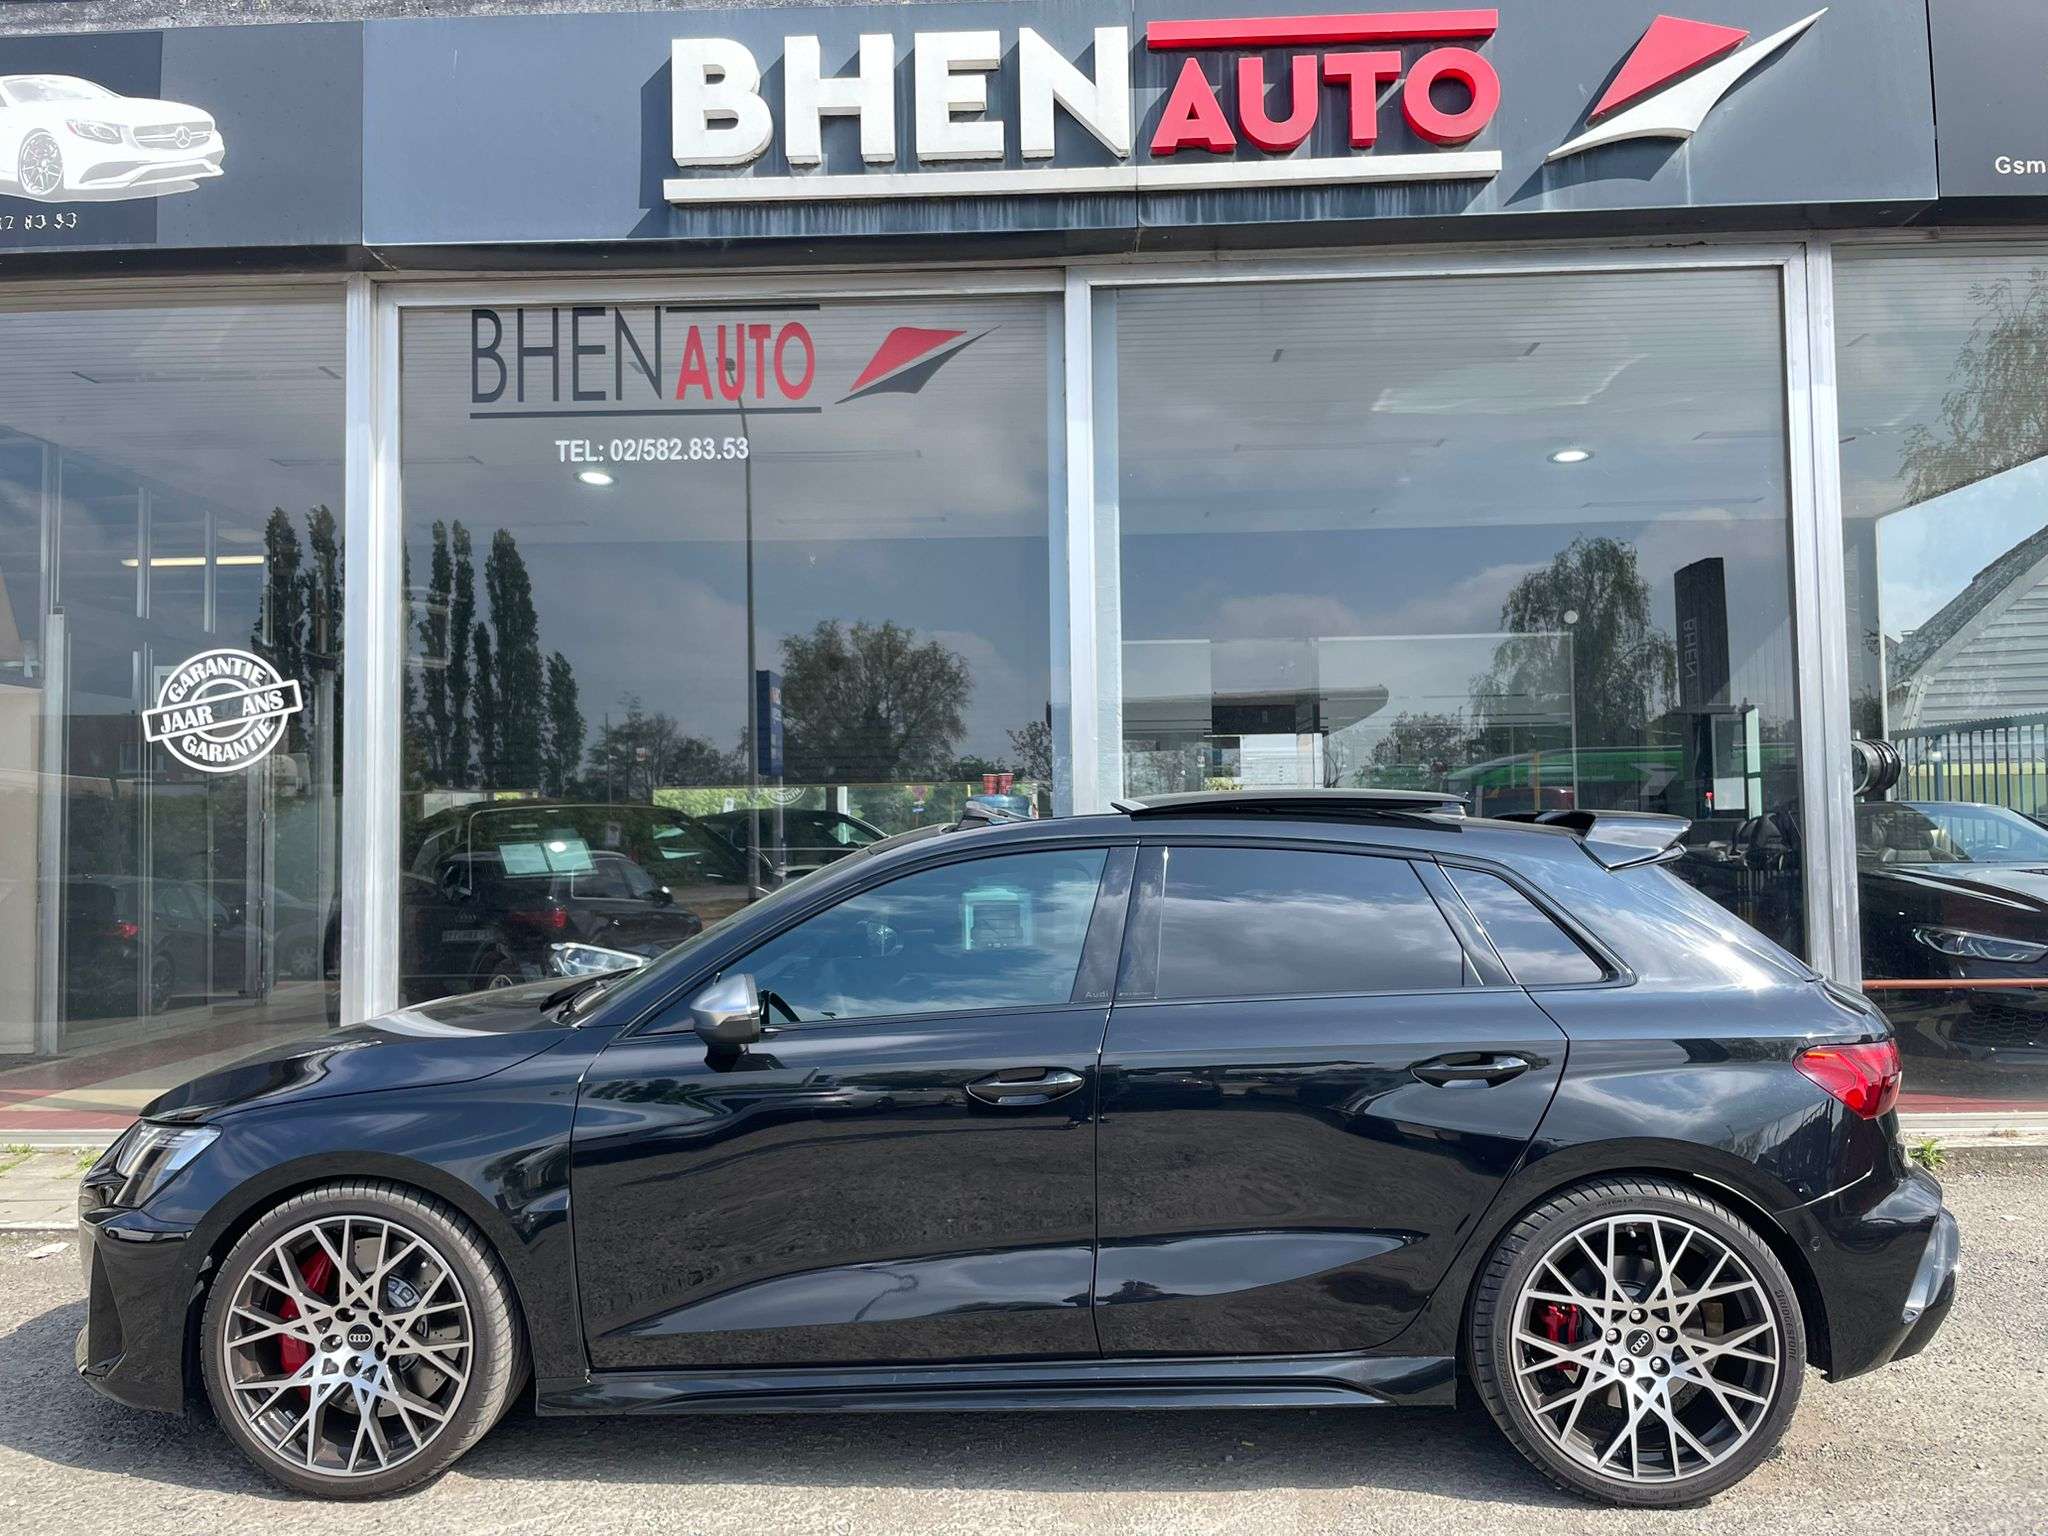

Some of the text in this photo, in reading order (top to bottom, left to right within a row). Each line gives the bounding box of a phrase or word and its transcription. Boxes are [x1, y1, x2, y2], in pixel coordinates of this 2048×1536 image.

[671, 26, 1501, 167] BHEN AUTO
[1995, 155, 2047, 175] Gsm
[471, 305, 816, 404] BHEN AUTO
[555, 437, 750, 463] TEL: 02/582.83.53
[168, 656, 267, 703] GARANTIE
[160, 689, 285, 734] JAAR ANS
[181, 718, 276, 763] GARANTIE
